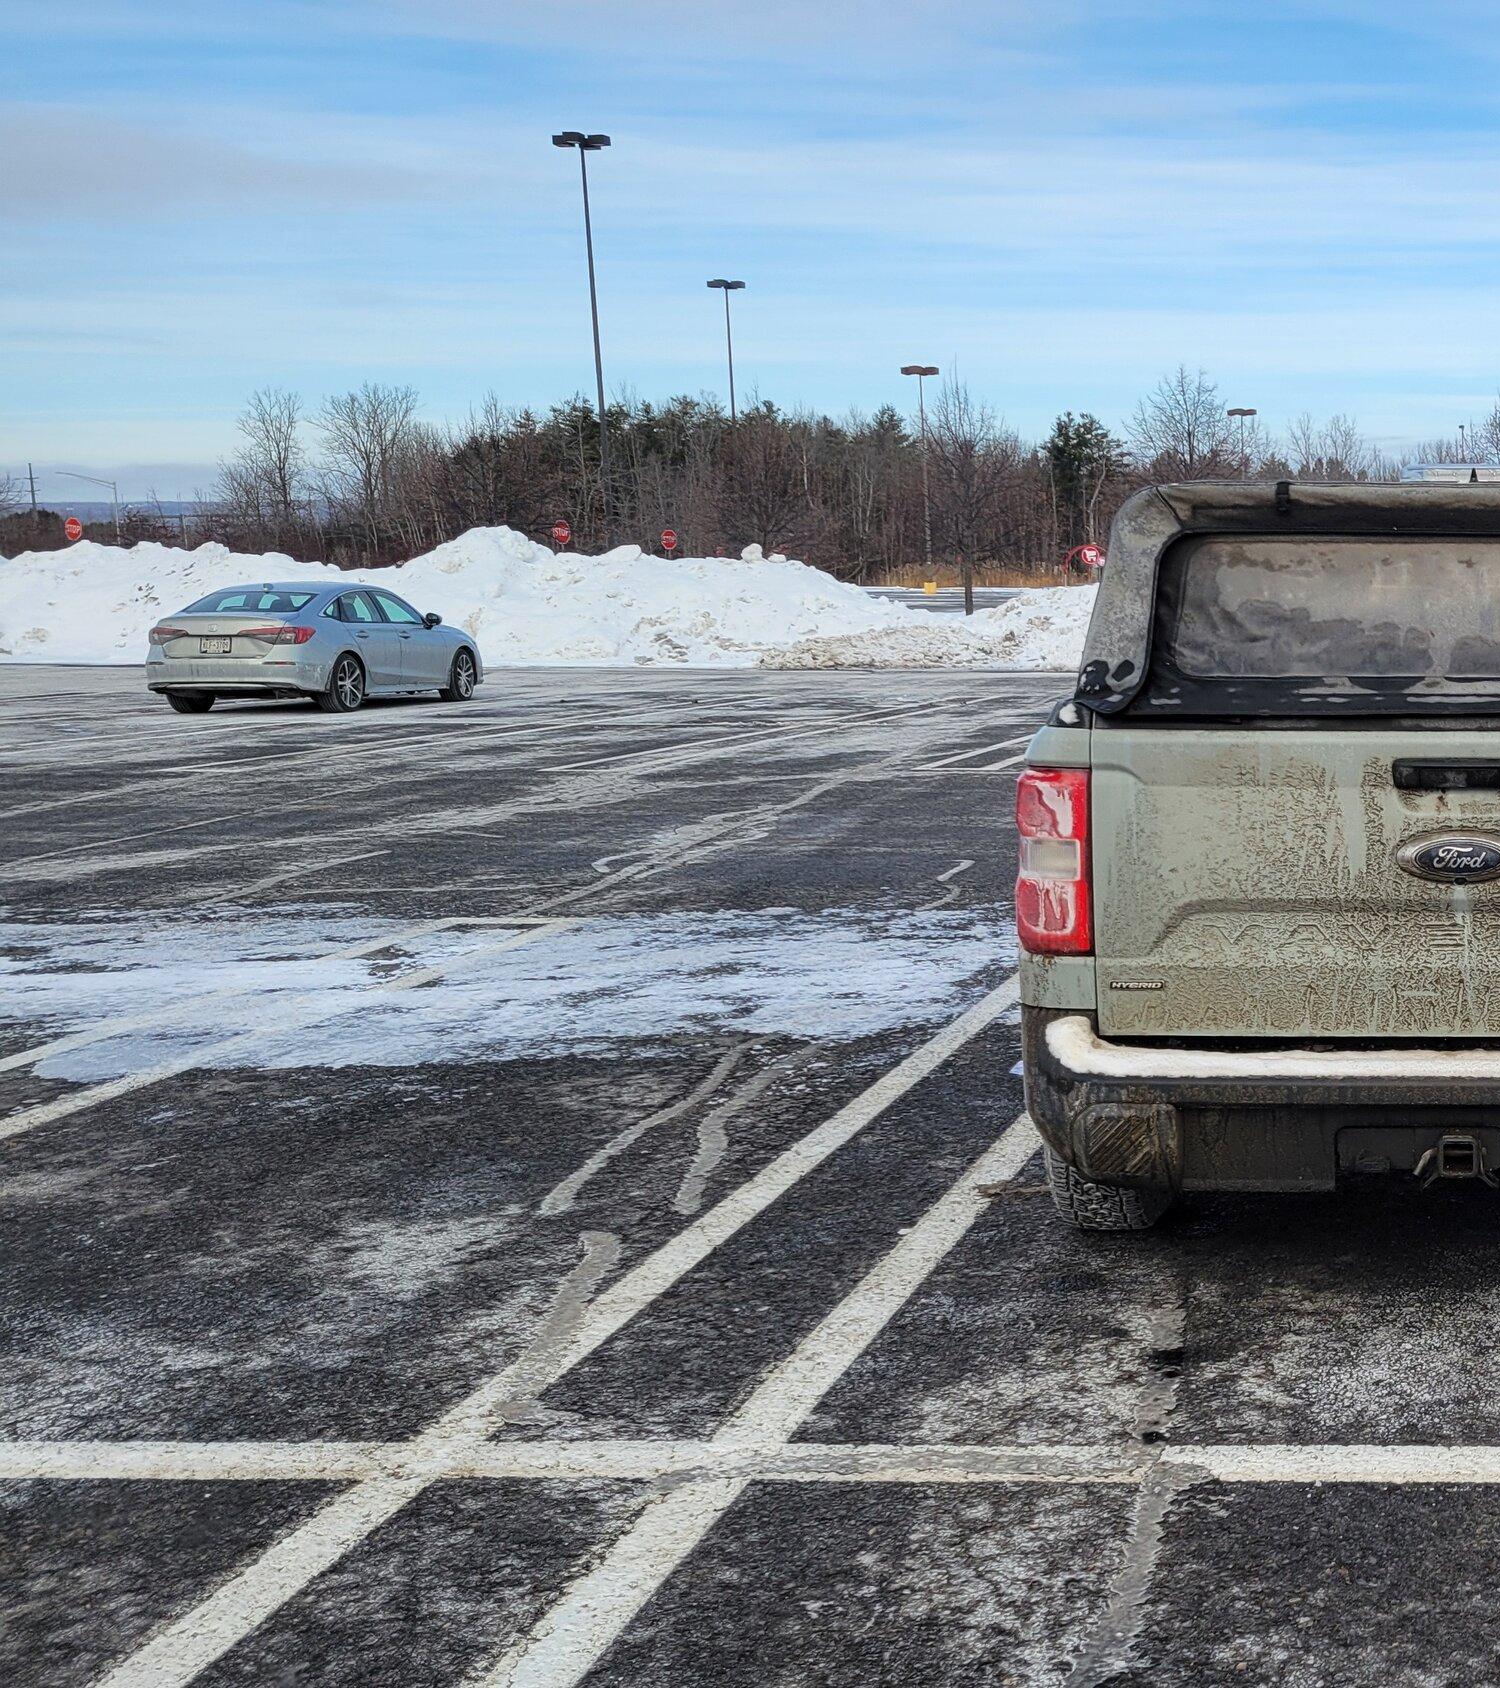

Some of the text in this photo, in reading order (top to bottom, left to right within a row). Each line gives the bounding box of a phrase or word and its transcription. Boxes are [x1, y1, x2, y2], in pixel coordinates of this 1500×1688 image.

[65, 524, 81, 534] STOP
[554, 527, 569, 537] STOP
[1433, 846, 1487, 869] Ford
